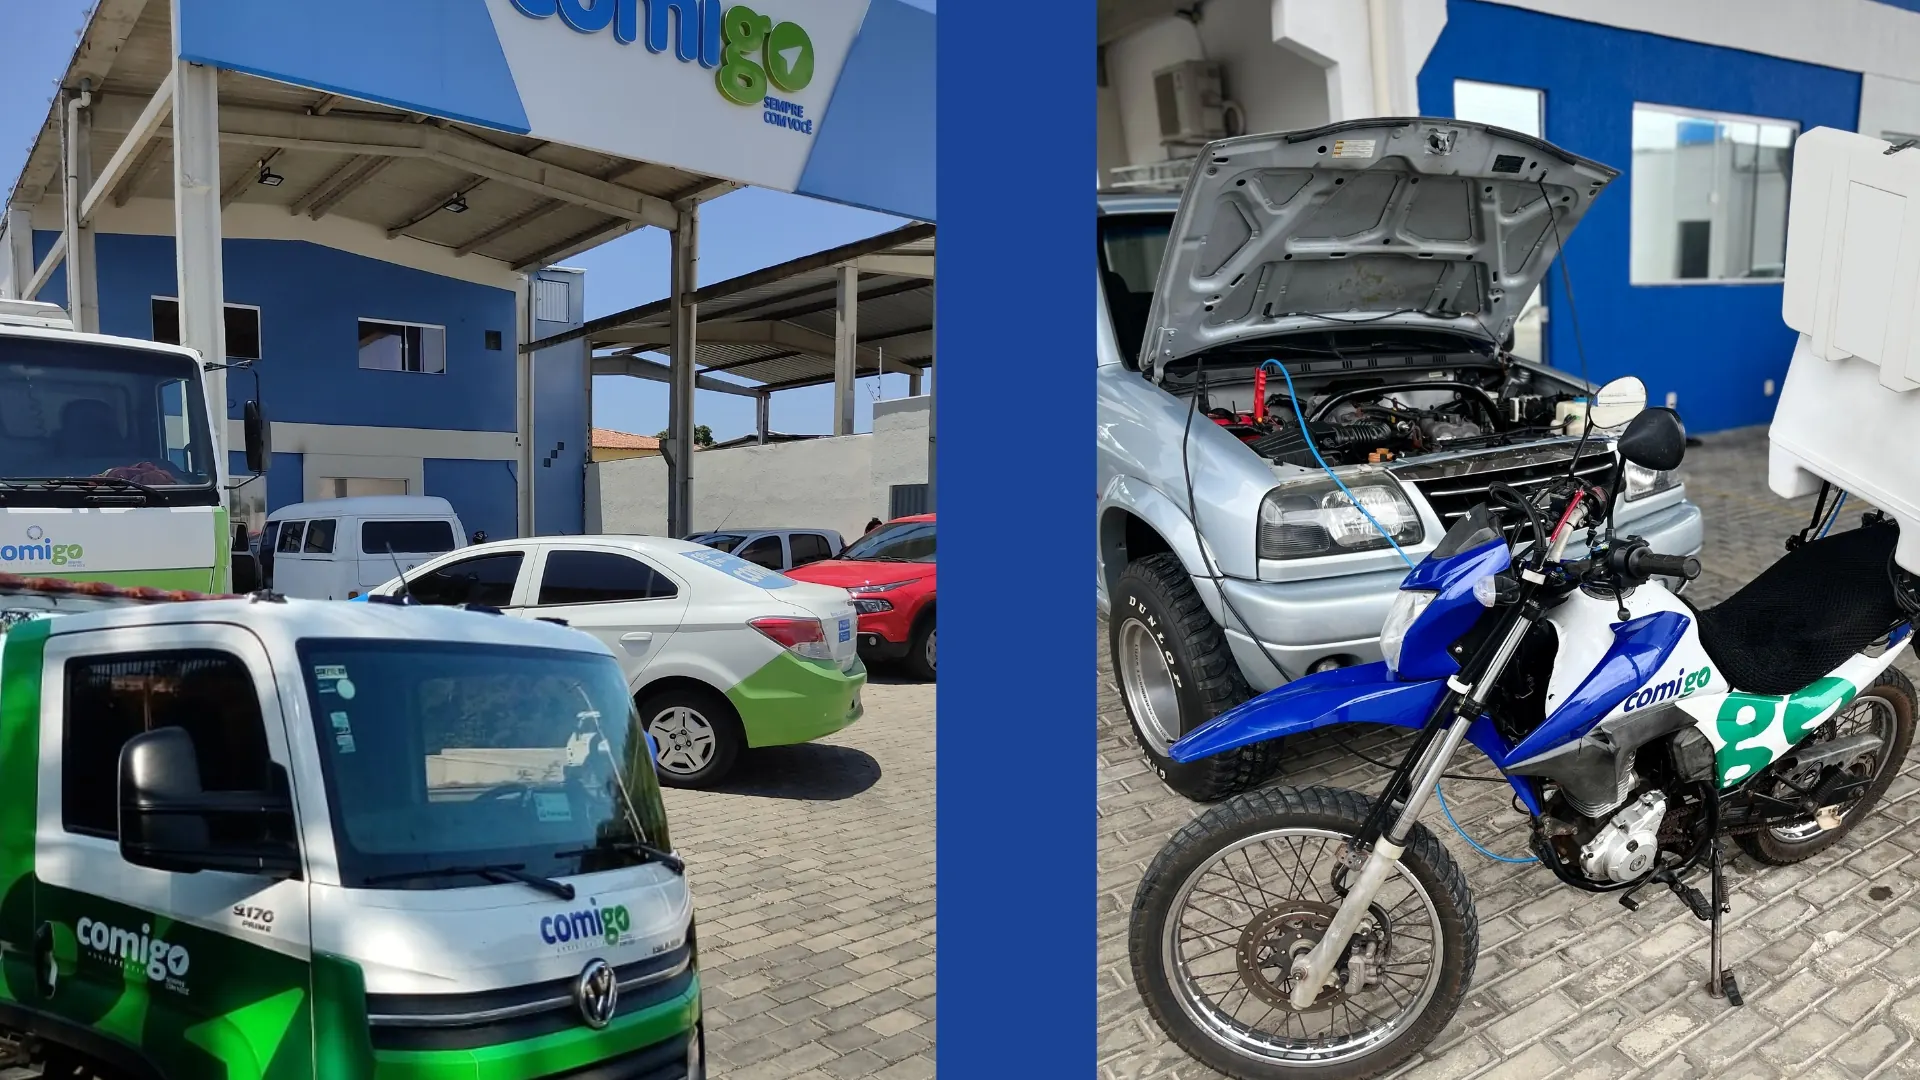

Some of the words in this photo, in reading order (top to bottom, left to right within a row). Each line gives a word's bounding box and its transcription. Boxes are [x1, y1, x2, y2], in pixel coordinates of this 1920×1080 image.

[763, 96, 804, 118] SEMPRE
[763, 111, 787, 127] COM
[787, 116, 813, 135] VOCÊ
[0, 537, 83, 566] omigo
[1129, 595, 1183, 689] DUNLOP
[1623, 666, 1711, 713] comigo
[241, 919, 272, 932] PRIME
[540, 896, 630, 945] comigo
[76, 916, 190, 981] comigo
